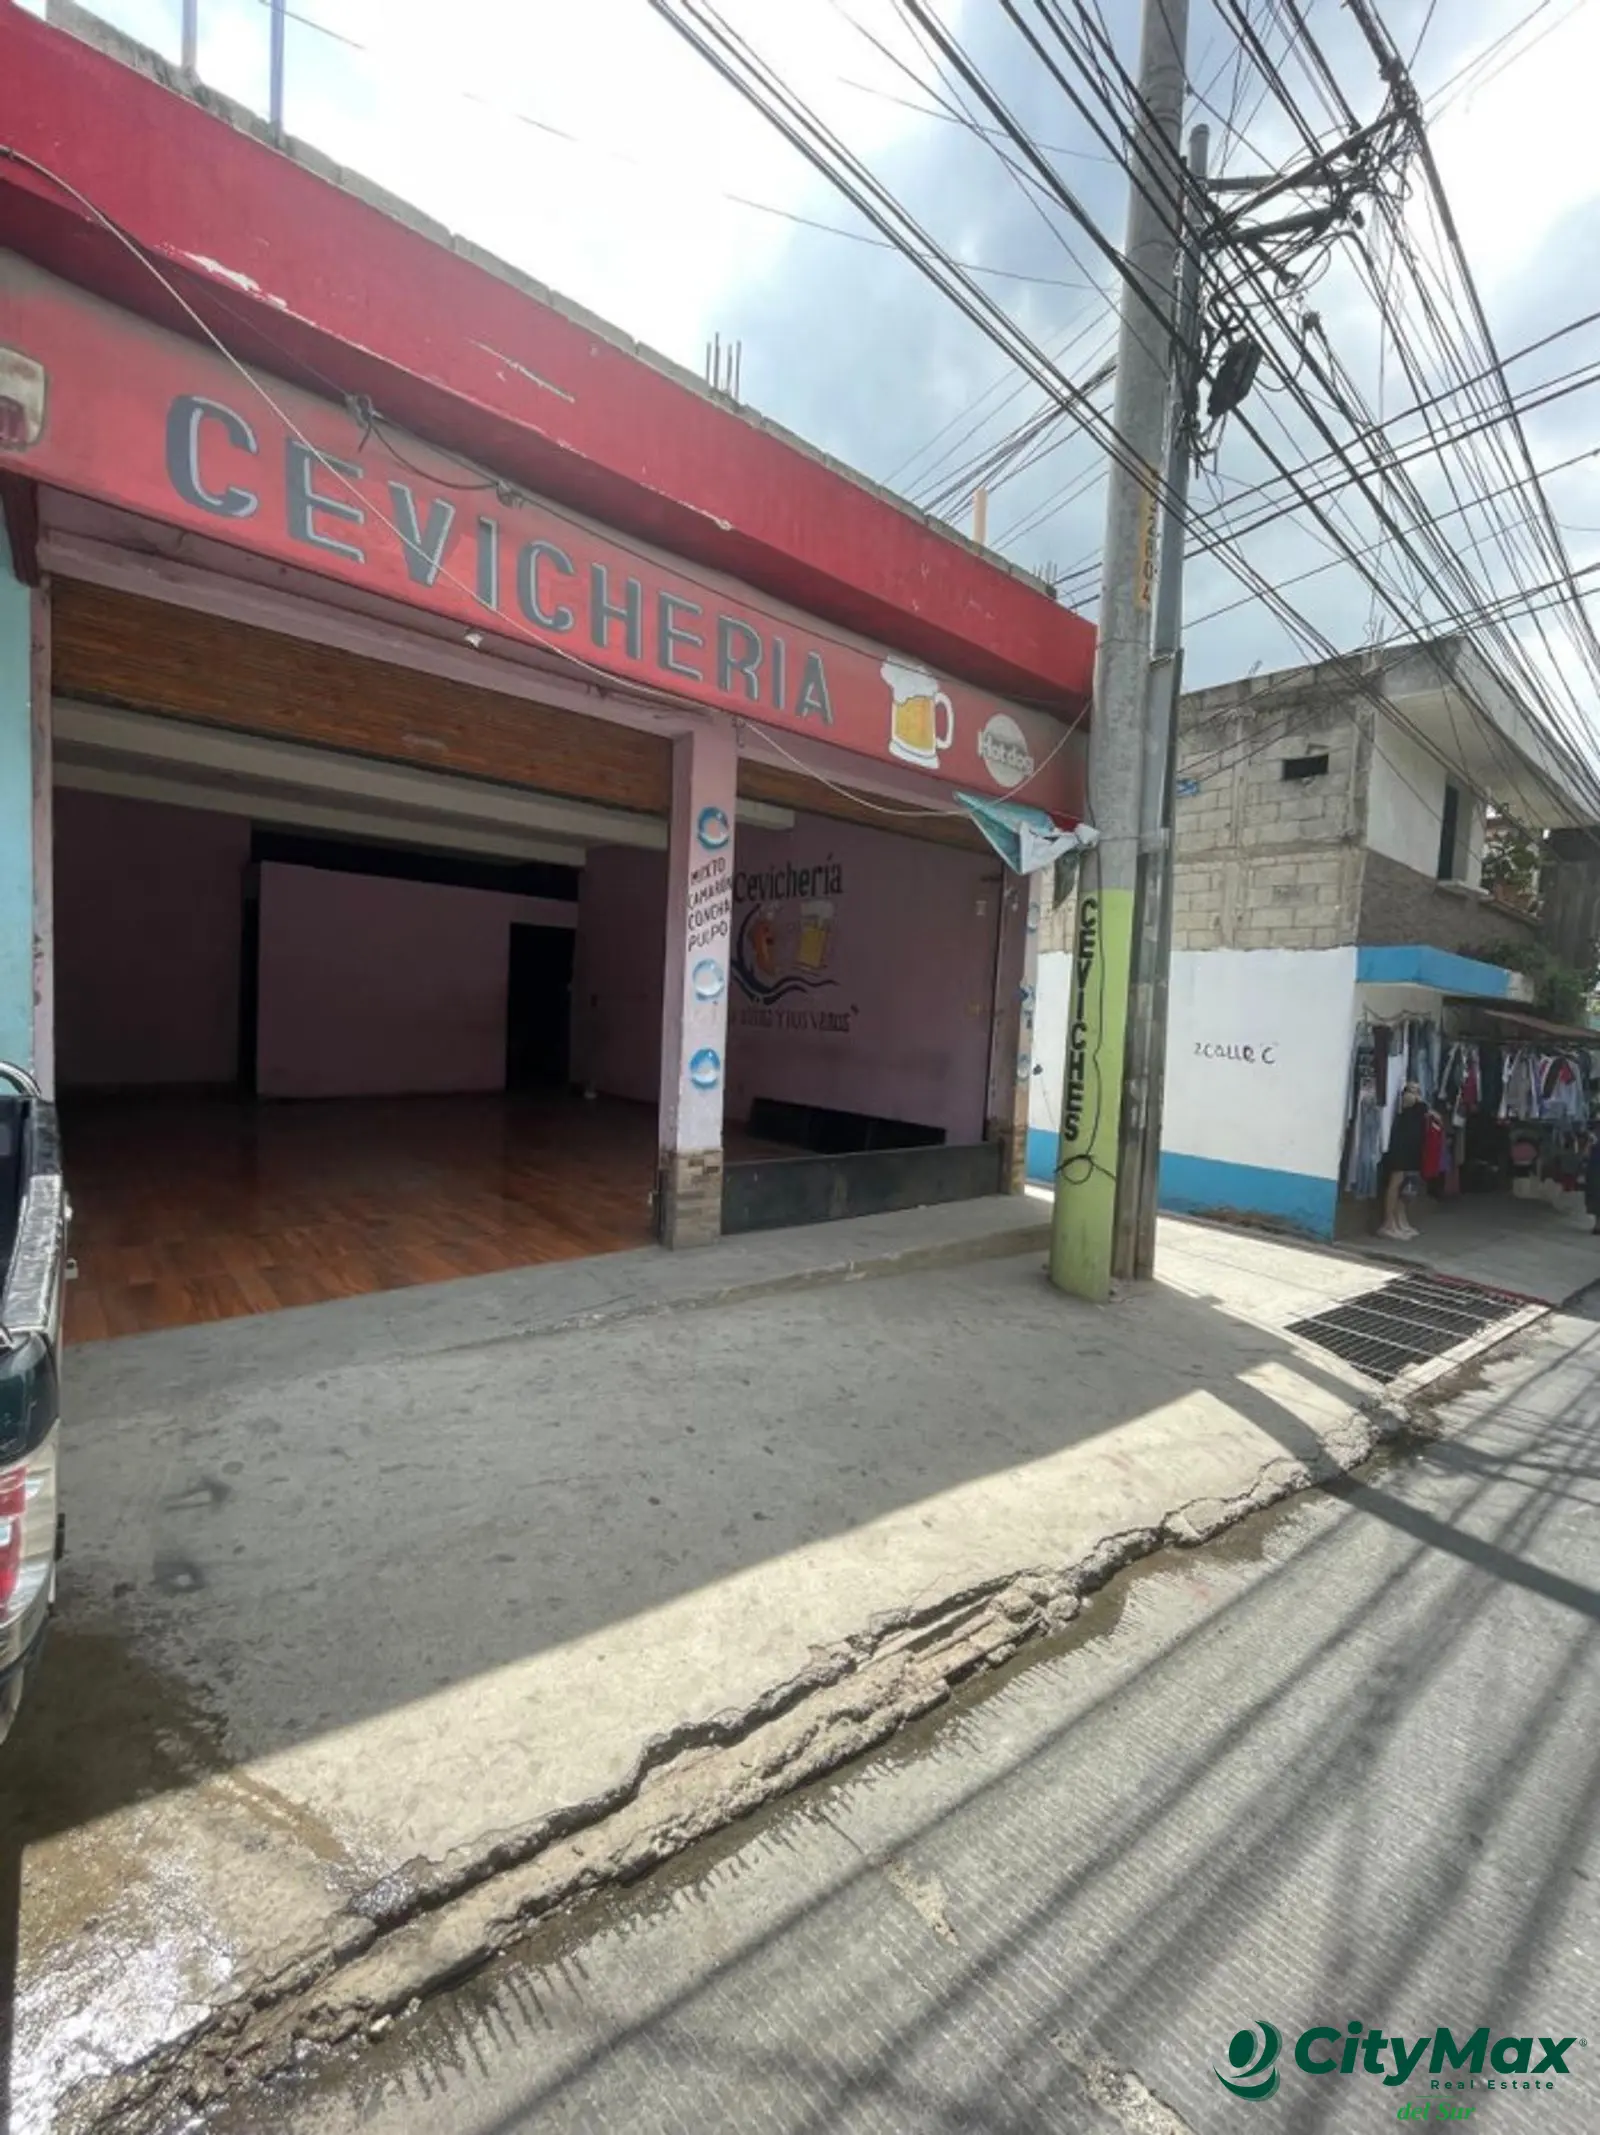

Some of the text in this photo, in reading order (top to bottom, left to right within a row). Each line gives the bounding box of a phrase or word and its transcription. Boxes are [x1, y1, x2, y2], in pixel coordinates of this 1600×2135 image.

[166, 394, 833, 726] CEVICHERIA
[691, 856, 727, 886] MIXTO
[733, 851, 843, 903] Cevichería
[688, 899, 730, 931] CONCHA
[688, 920, 728, 952] PULPO
[1064, 897, 1097, 1142] CEVICHES
